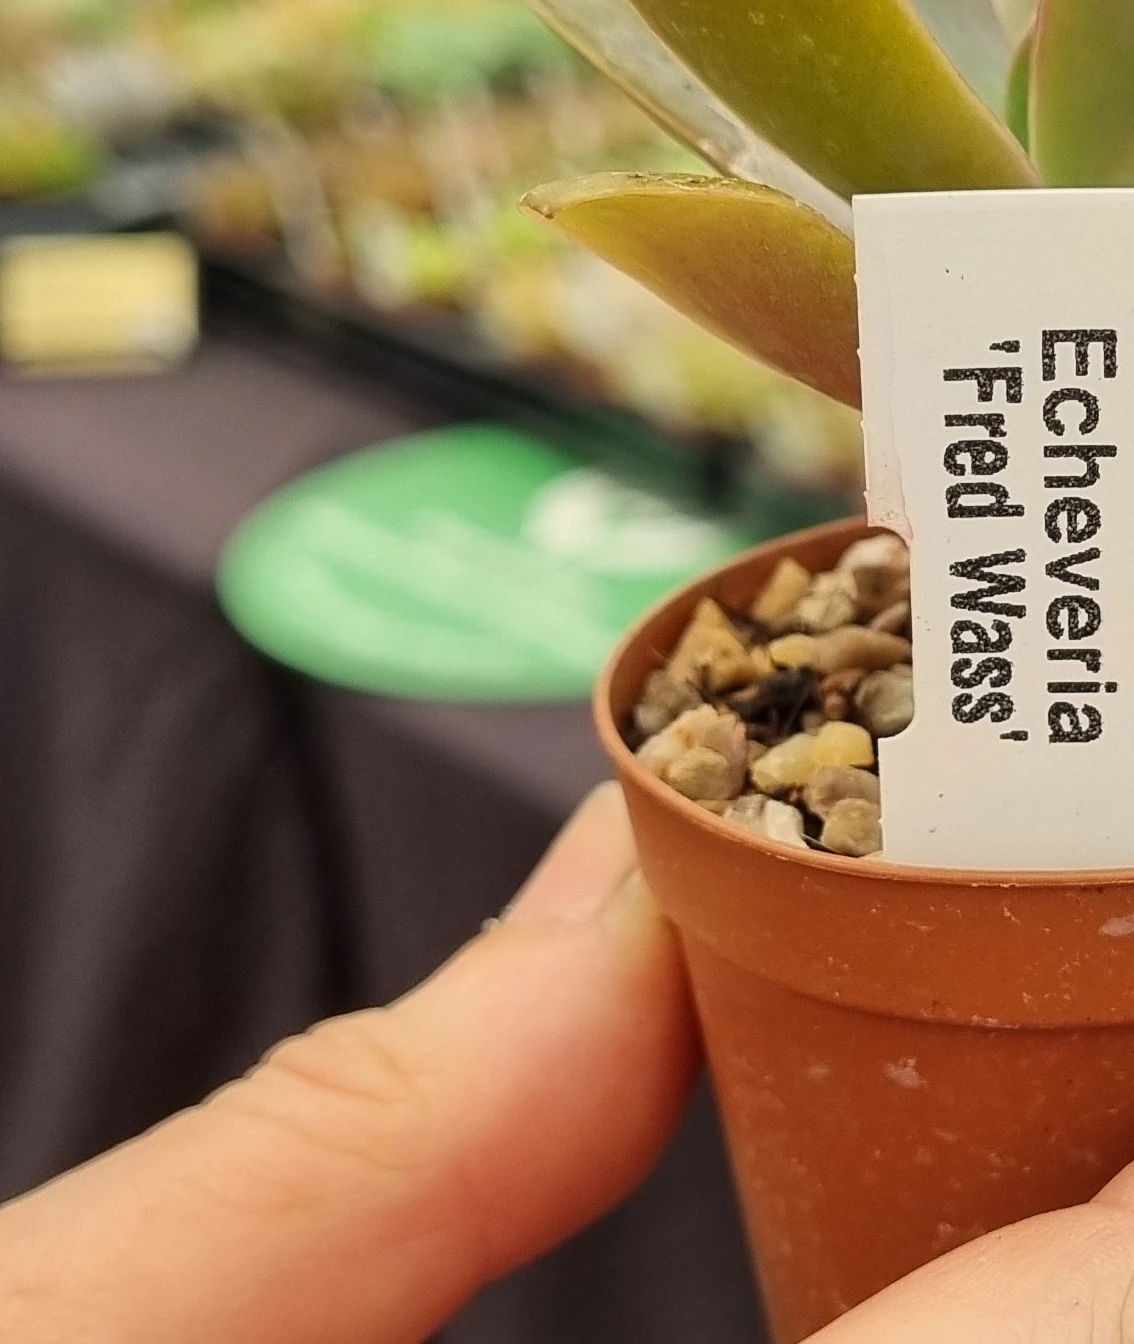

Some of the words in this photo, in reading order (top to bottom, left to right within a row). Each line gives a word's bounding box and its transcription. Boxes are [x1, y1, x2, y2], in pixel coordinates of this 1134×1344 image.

[942, 339, 1025, 519] 'Fred
[1041, 328, 1118, 744] Echeveria
[948, 548, 1029, 742] Wass'
